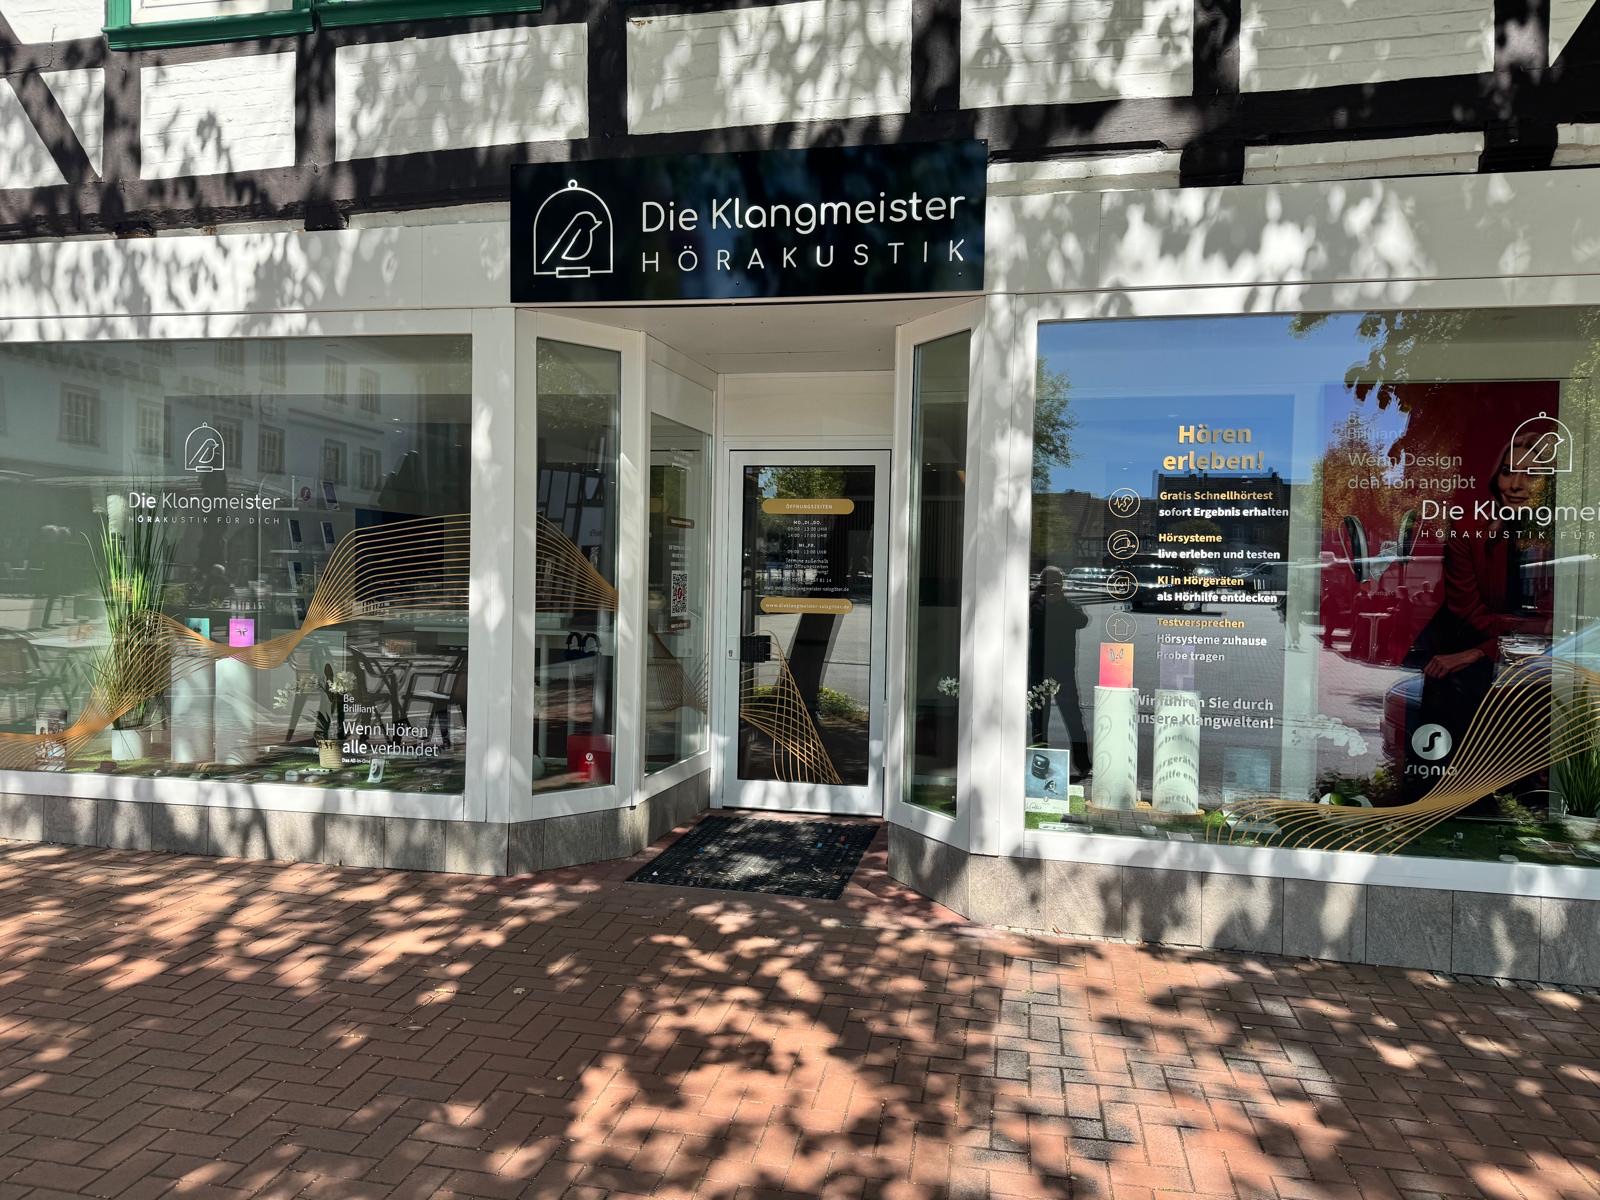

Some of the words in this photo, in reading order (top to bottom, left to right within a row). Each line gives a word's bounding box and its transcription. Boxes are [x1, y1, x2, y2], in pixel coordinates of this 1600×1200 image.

[642, 201, 698, 232] Die
[712, 191, 966, 234] Klangmeister
[642, 239, 965, 272] HÖRAKUSTIK
[1178, 424, 1252, 444] Hören
[1163, 451, 1265, 471] erleben!
[1348, 452, 1397, 467] Wenn
[1403, 452, 1462, 470] Design
[1348, 475, 1379, 489] den
[1383, 476, 1414, 489] Ton
[1420, 475, 1476, 492] angibt
[129, 492, 156, 509] Die
[162, 492, 281, 513] Klangmeister
[1160, 490, 1192, 501] Gratis
[1194, 490, 1273, 501] Schnellhörtest
[128, 515, 208, 524] HÖRAKUSTIK
[217, 515, 240, 524] FÜR
[249, 516, 280, 525] DICH
[1158, 507, 1191, 517] sofort
[1193, 507, 1241, 519] Ergebnis
[1242, 507, 1289, 517] erhalten
[1421, 500, 1465, 521] Die
[1474, 500, 1600, 526] Klangmei
[1158, 533, 1223, 544] Hörsysteme
[1421, 528, 1545, 540] HÖRAKUSTIK
[1560, 529, 1596, 540] FÜR
[1158, 549, 1177, 559] live
[1179, 549, 1221, 559] erleben
[1223, 549, 1243, 559] und
[1246, 550, 1281, 560] testen
[1157, 575, 1169, 585] KI
[1171, 575, 1181, 585] in
[1183, 576, 1244, 588] Hörgeräten
[1157, 592, 1173, 602] als
[1175, 592, 1219, 602] Hörhilfe
[1221, 592, 1278, 603] entdecken
[1157, 617, 1245, 629] Testversprechen
[1156, 634, 1220, 646] Hörsysteme
[1222, 635, 1268, 646] zuhause
[1156, 651, 1188, 661] Probe
[1190, 652, 1225, 663] tragen
[343, 694, 355, 703] Be
[1135, 694, 1154, 706] Wir
[1208, 697, 1229, 709] Sie
[1233, 698, 1274, 710] durch
[1132, 713, 1178, 725] unsere
[1182, 713, 1274, 730] Klangwelten!
[342, 721, 381, 736] Wenn
[386, 723, 428, 738] Hören
[342, 739, 368, 754] alle
[370, 741, 439, 757] verbindet
